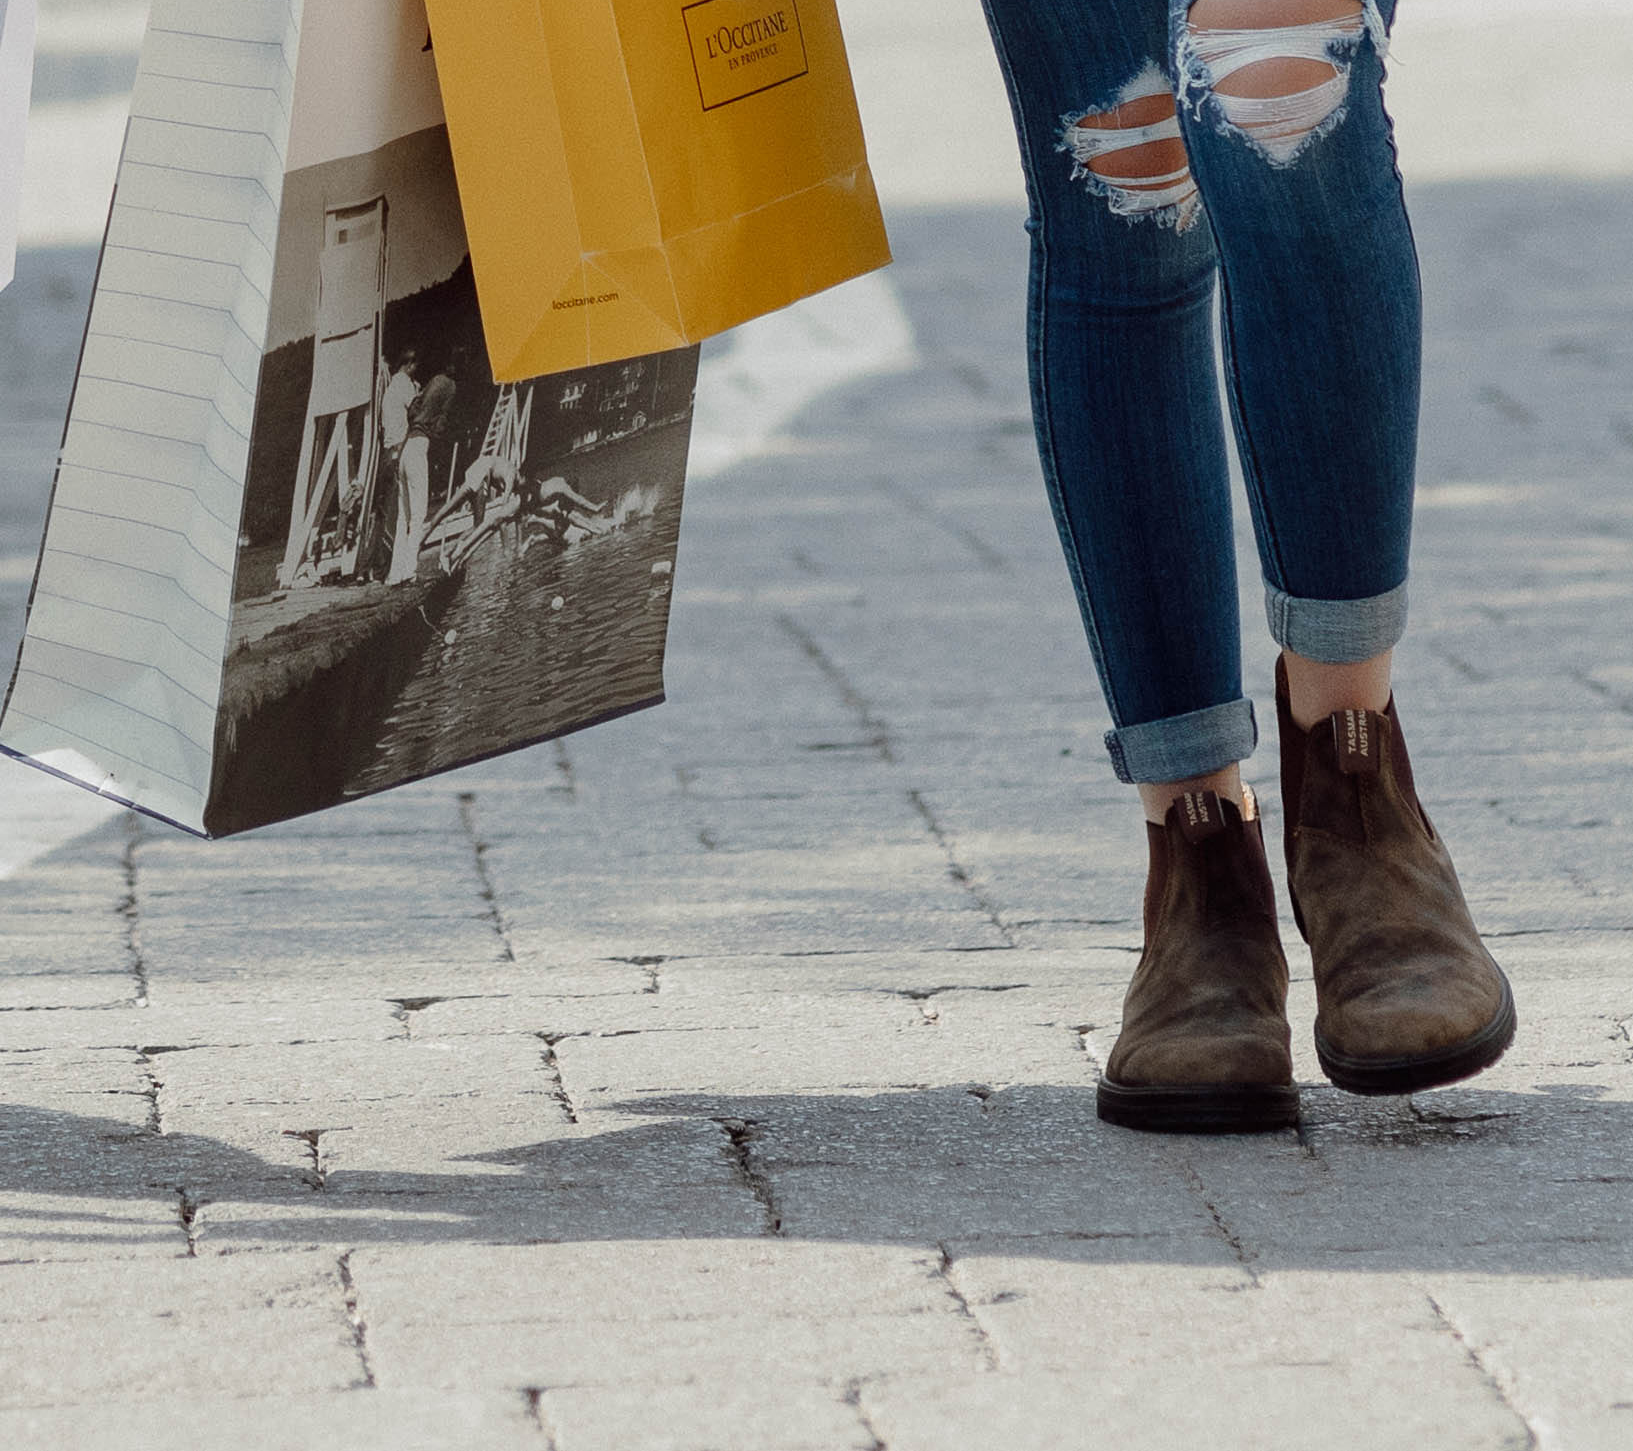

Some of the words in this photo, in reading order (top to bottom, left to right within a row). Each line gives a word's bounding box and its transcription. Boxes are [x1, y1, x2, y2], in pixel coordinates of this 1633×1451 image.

[706, 11, 789, 59] L'OCCITANE
[728, 57, 740, 71] EN
[741, 43, 779, 66] PROVENCE
[551, 293, 619, 310] loccitane.com
